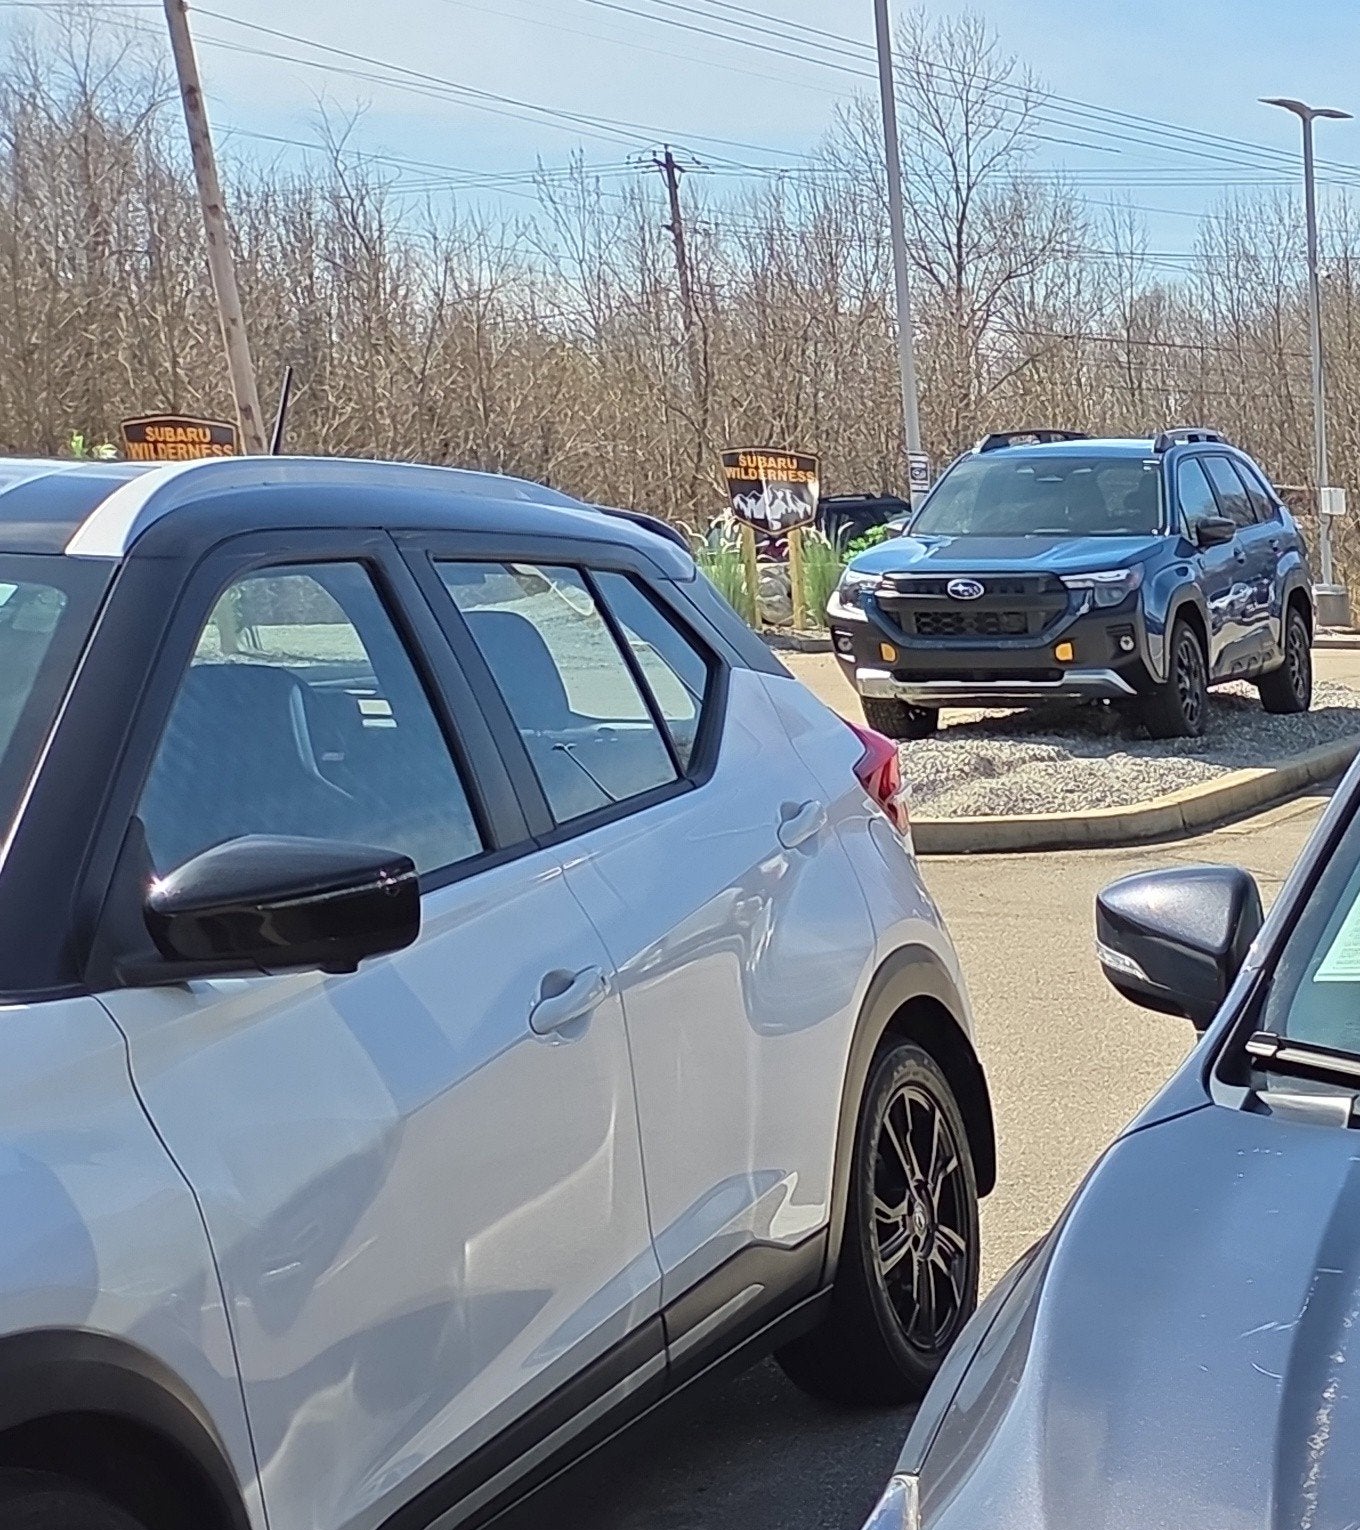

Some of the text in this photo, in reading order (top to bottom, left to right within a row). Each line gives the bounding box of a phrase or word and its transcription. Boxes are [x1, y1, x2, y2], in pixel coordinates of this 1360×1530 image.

[145, 426, 211, 442] SUBARU
[127, 443, 233, 459] WILDERNESS
[739, 454, 797, 469] SUBARU
[725, 467, 815, 482] WILDERNESS
